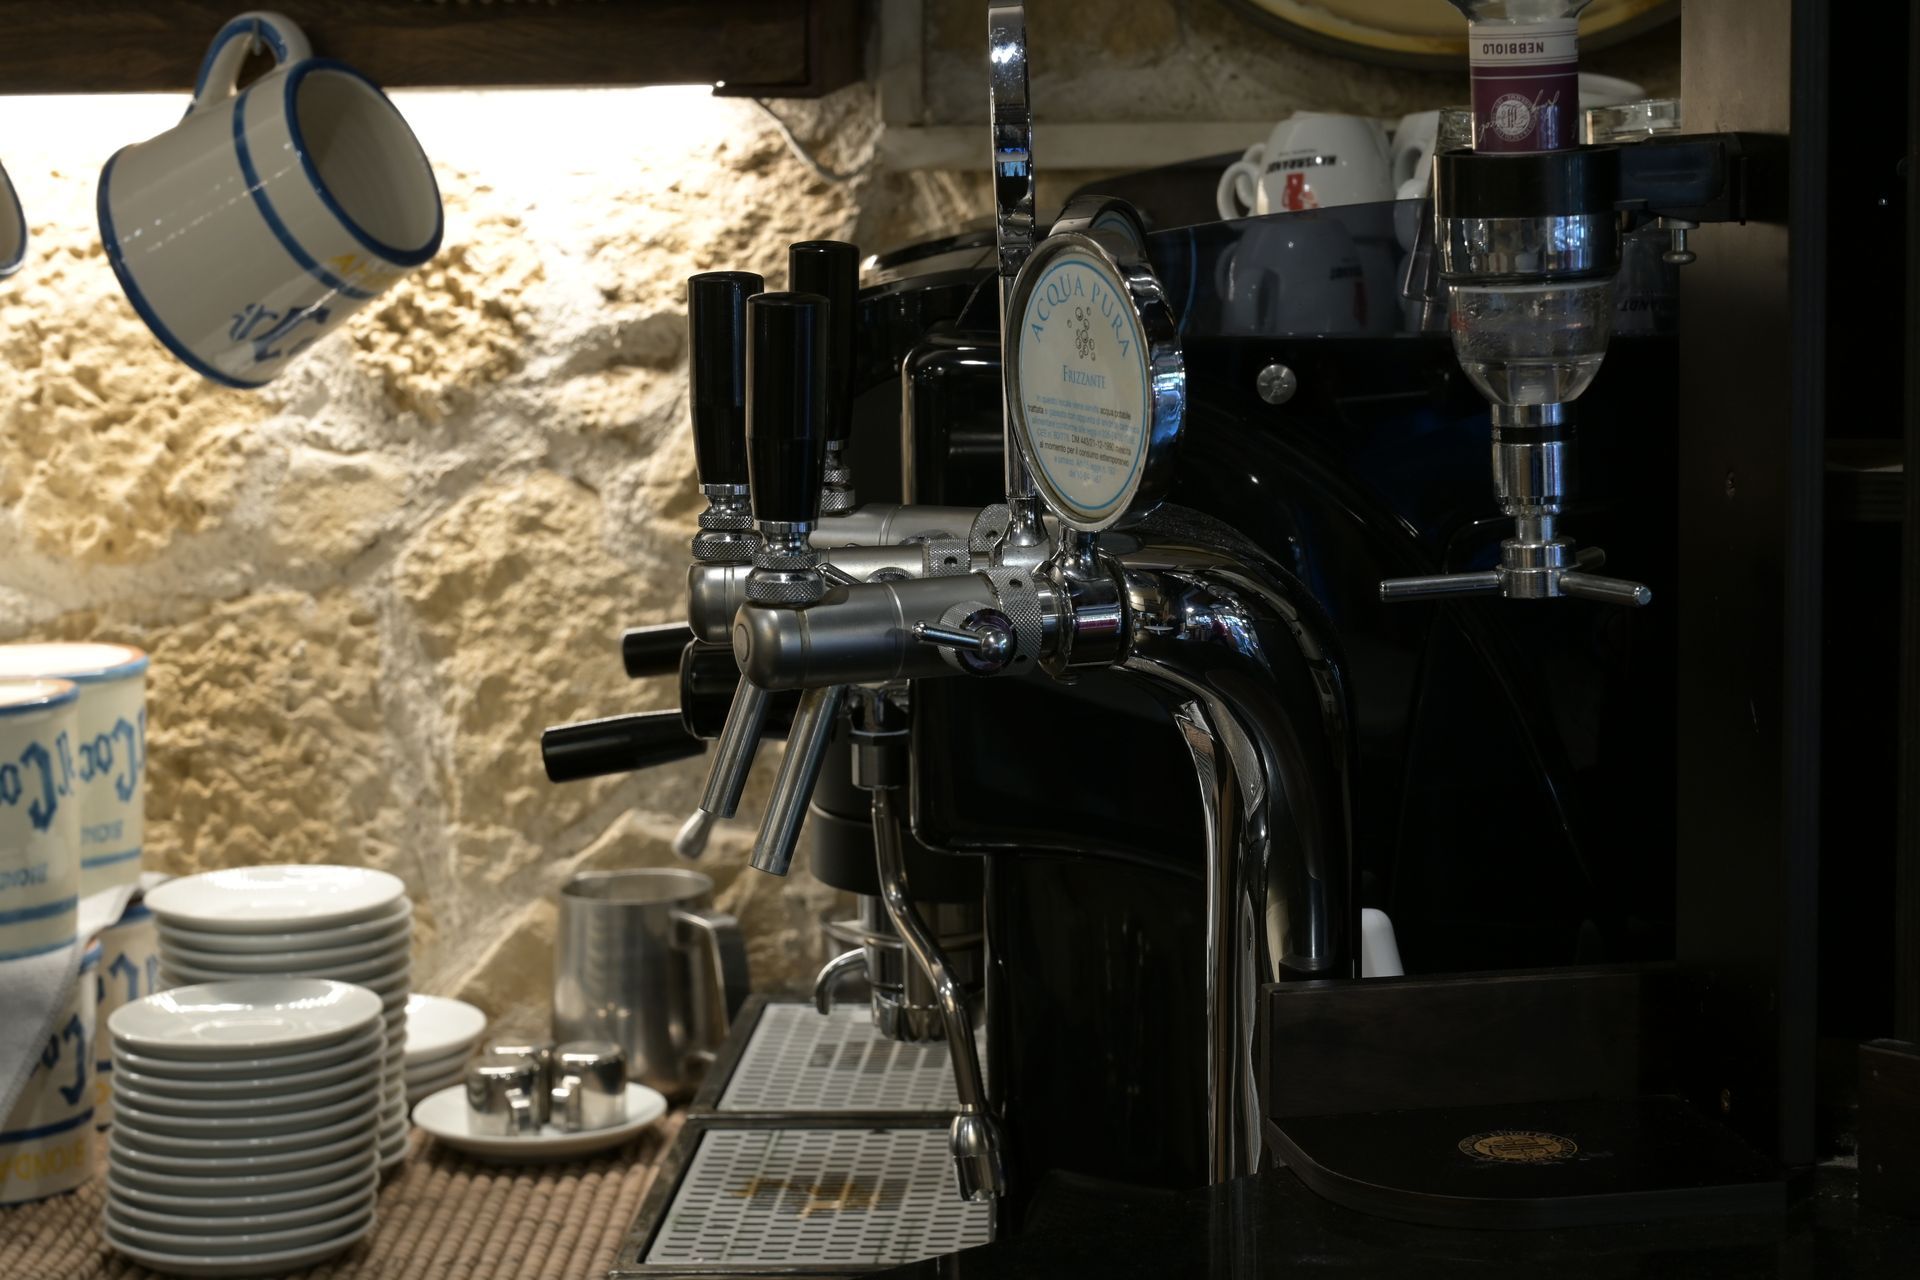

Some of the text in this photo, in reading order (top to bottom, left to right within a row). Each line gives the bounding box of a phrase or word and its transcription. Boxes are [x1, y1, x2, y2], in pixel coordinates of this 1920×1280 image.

[1482, 41, 1544, 55] NEBBIOLO
[1030, 272, 1131, 358] ACQUA PURA
